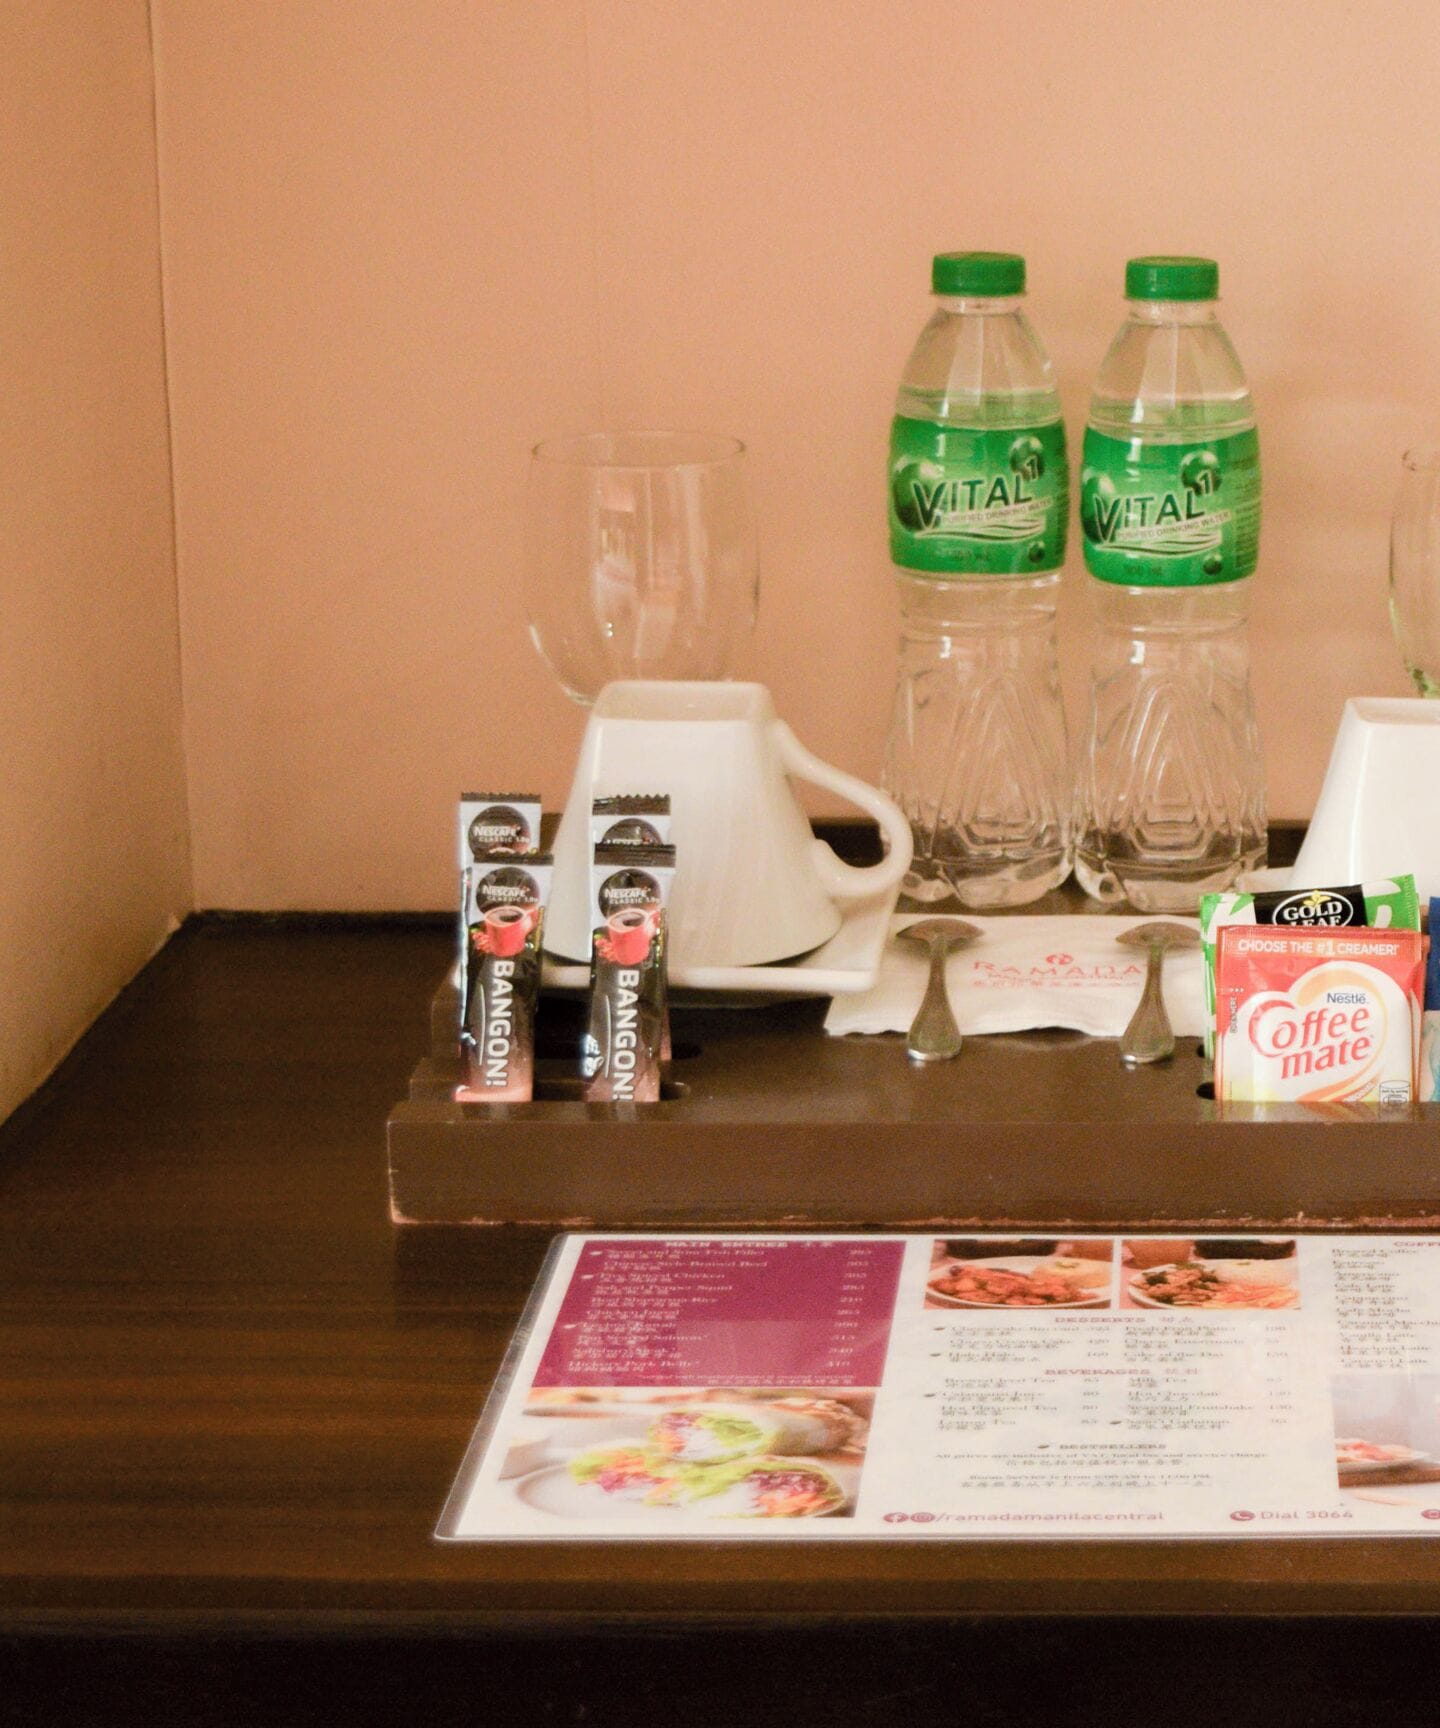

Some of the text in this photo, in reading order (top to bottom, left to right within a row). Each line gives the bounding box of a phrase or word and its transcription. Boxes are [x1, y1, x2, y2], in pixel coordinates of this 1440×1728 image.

[912, 474, 1033, 530] VITAL
[985, 505, 1025, 520] DRINKING
[1093, 488, 1205, 544] VITAL
[1156, 523, 1199, 537] DRINKING
[1201, 511, 1230, 527] WATER
[1283, 901, 1343, 921] GOLD
[1238, 939, 1288, 953] CHOOSE
[1290, 941, 1313, 954] THE
[1316, 939, 1335, 955] #1
[973, 961, 1142, 976] RAMADA
[485, 960, 515, 1087] BANGON!
[611, 969, 639, 1101] BANGON!
[1248, 999, 1370, 1058] Coffee
[1281, 1036, 1371, 1079] mate
[935, 1512, 1165, 1522] /ramadamanilacentral
[1260, 1511, 1299, 1520] Dial
